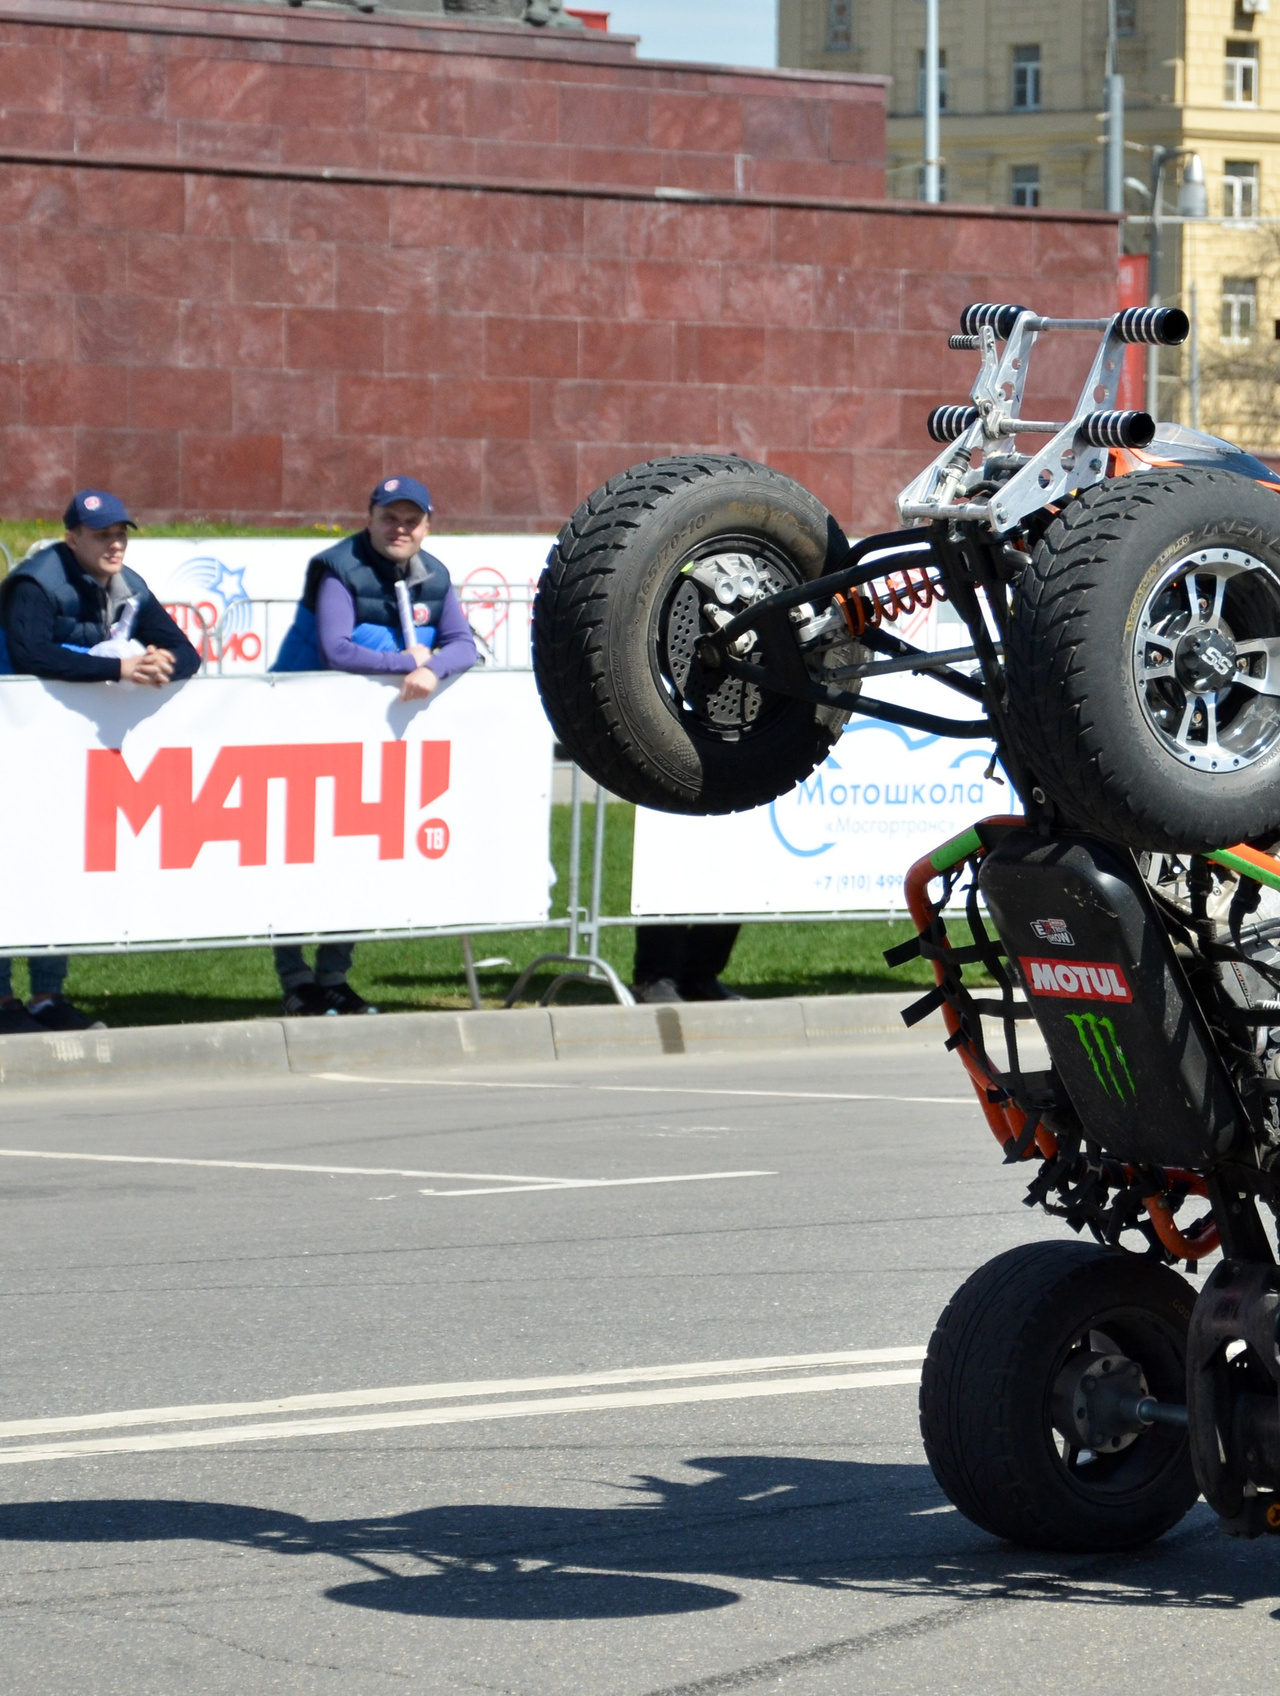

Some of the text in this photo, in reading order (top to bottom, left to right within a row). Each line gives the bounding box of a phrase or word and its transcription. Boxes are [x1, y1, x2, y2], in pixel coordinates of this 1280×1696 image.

[638, 513, 707, 607] 165/70-10
[162, 601, 218, 631] ВТО
[196, 632, 262, 662] ДИО
[1201, 646, 1235, 675] SS
[797, 773, 985, 806] Мотошкола
[84, 740, 451, 872] МАТЧ!
[424, 826, 448, 851] ТВ
[825, 816, 956, 838] «Мосгортранс»
[814, 876, 832, 890] +7
[837, 875, 870, 893] (910)
[1030, 963, 1127, 997] MOTUL
